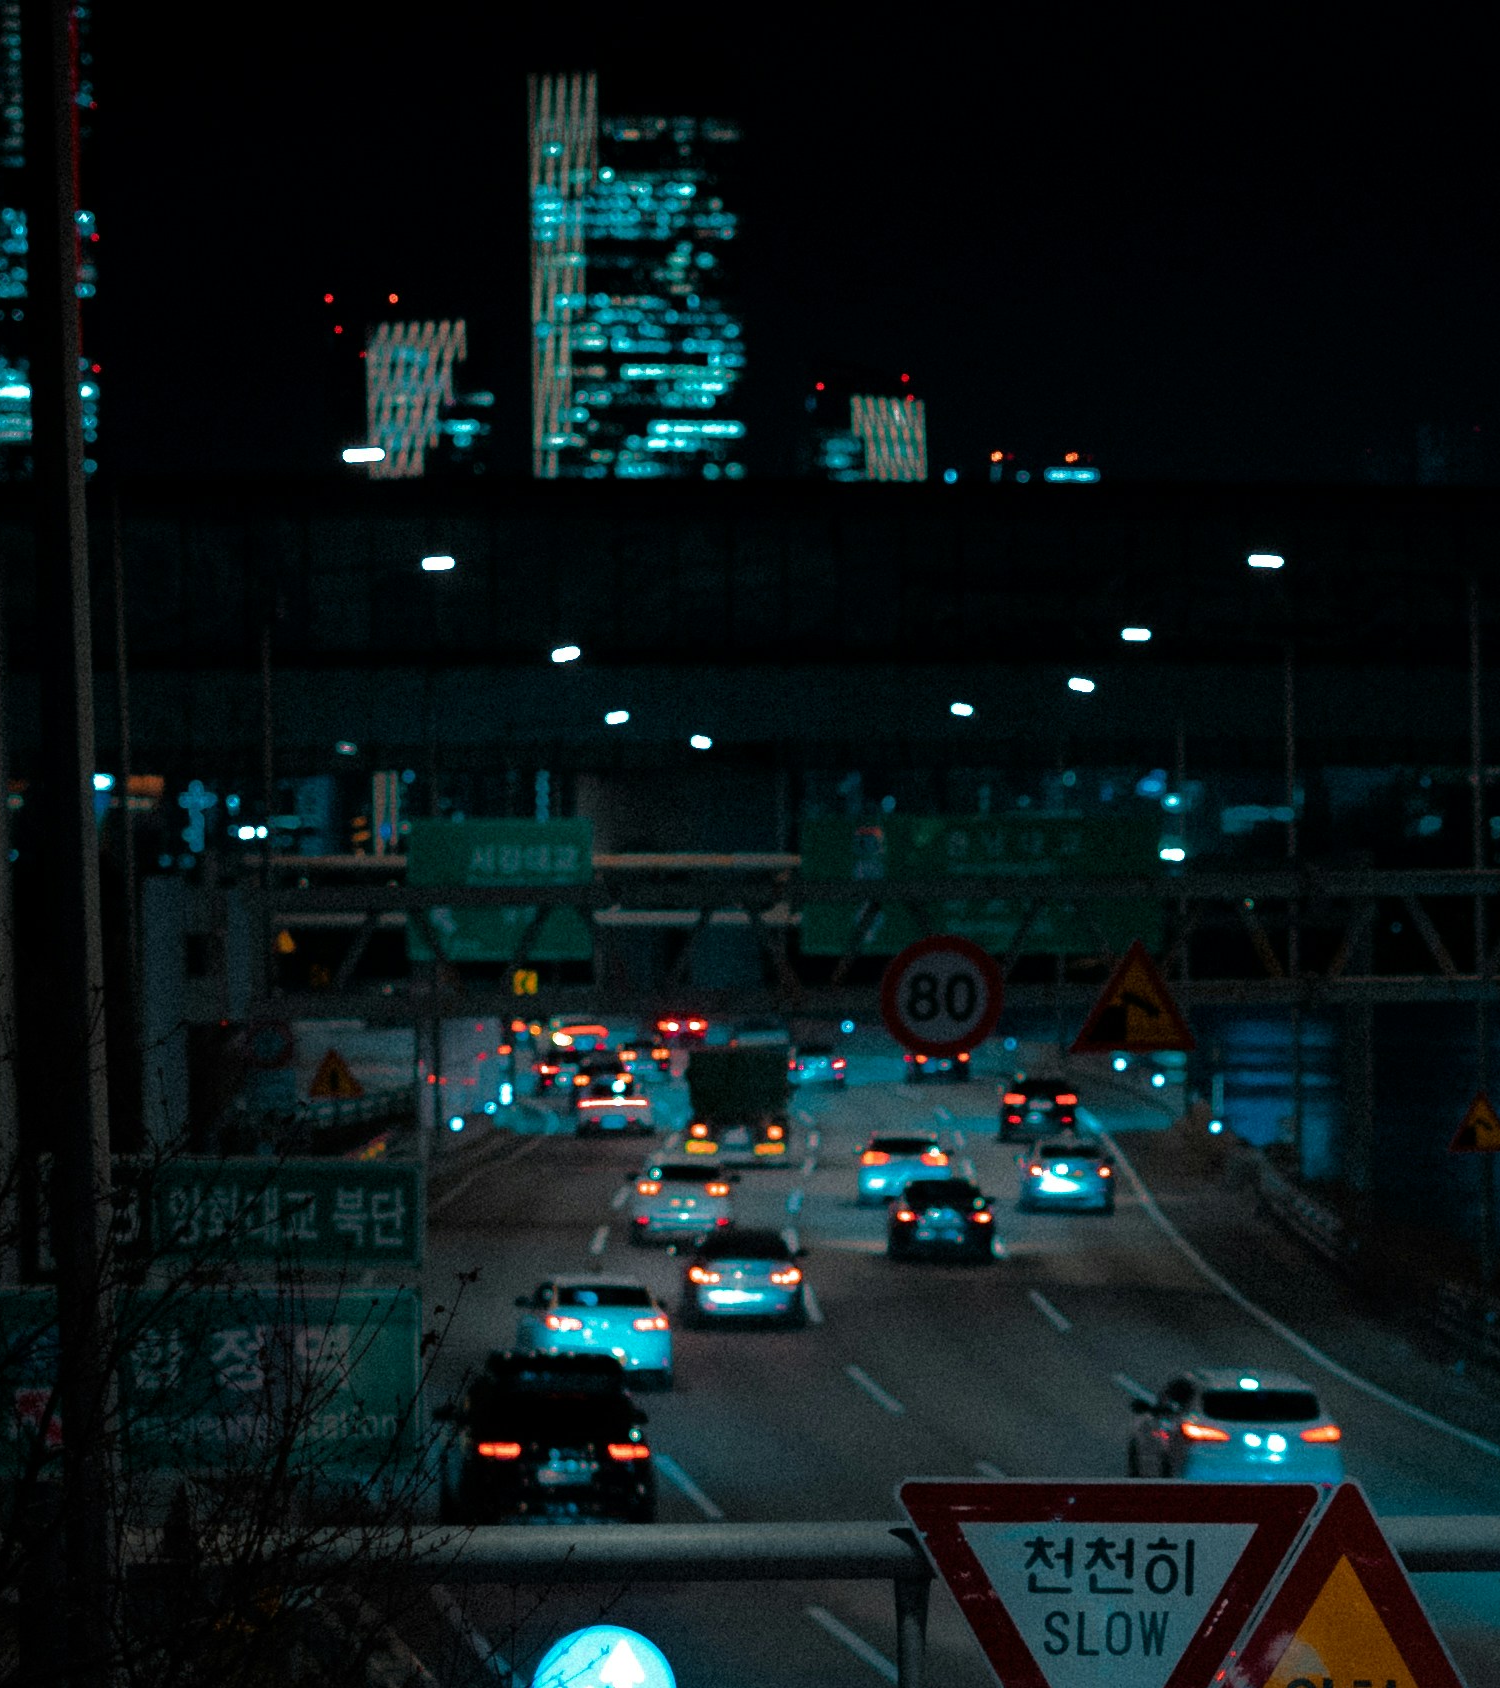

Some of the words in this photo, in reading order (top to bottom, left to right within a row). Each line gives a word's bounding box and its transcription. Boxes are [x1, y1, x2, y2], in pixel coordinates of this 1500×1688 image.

[907, 972, 977, 1023] 80
[332, 1185, 407, 1247] 북단
[1023, 1535, 1197, 1597] 천천히
[1043, 1610, 1170, 1657] SLOW
